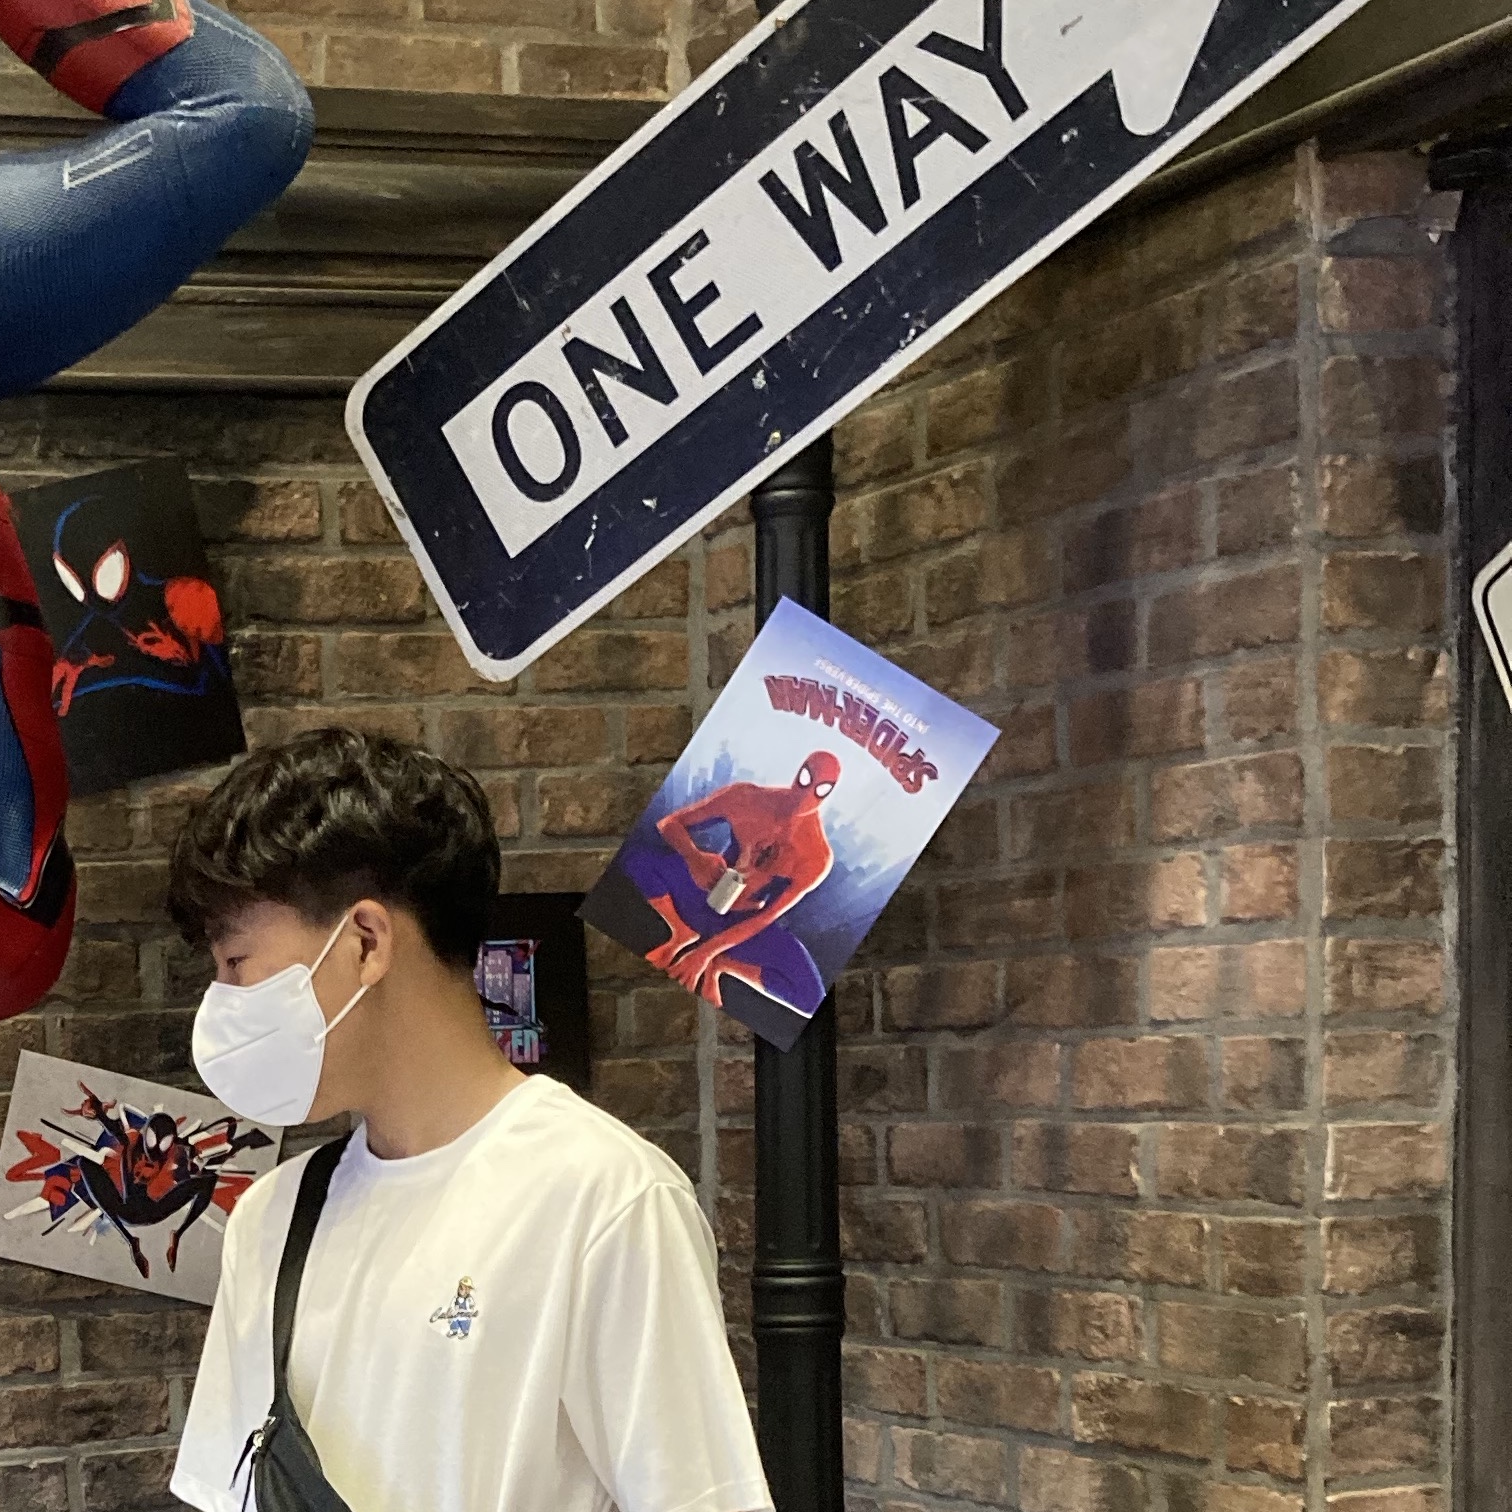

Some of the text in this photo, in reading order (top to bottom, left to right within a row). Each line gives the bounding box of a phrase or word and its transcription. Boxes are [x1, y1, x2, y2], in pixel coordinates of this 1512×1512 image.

[491, 0, 1029, 502] ONE WAY
[763, 674, 939, 795] SPIDER-MAN
